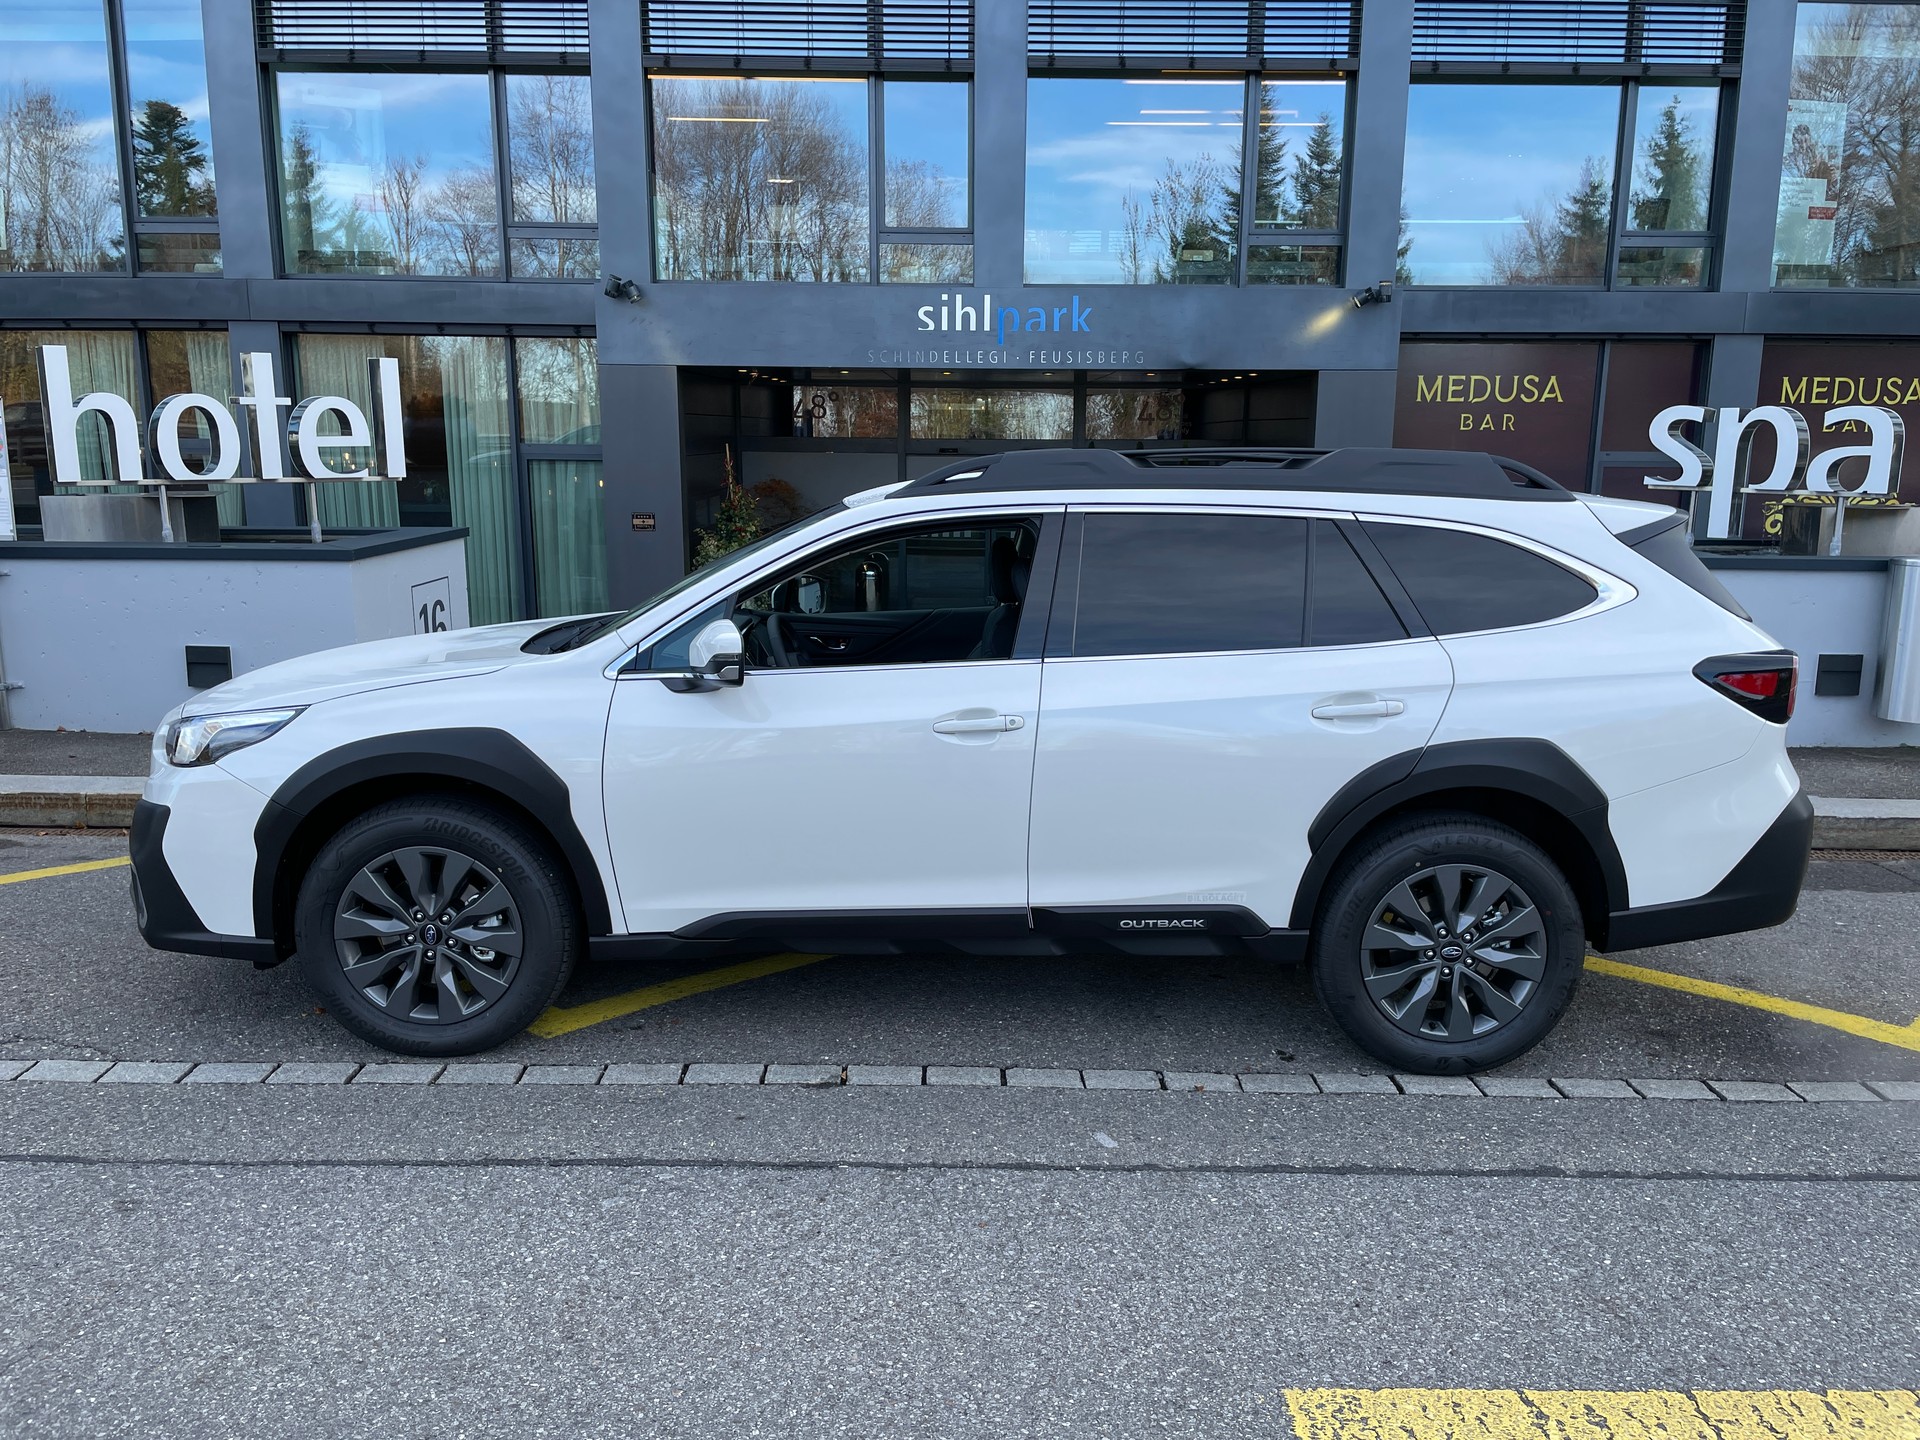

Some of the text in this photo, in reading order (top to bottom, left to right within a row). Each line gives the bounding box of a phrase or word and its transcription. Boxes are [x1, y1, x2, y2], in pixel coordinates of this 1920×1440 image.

[917, 293, 1093, 346] sihlpark
[867, 350, 1145, 364] SCHINDELLEGI FEUSISBERG
[1415, 374, 1564, 403] MEDUSA
[1779, 376, 1920, 406] MEDUSA
[37, 344, 407, 483] hotel
[1459, 413, 1516, 432] BAR
[1643, 404, 1907, 539] spa
[419, 599, 448, 634] 16
[421, 816, 534, 887] BRIDGESTONE
[1119, 919, 1205, 929] OUTBACK
